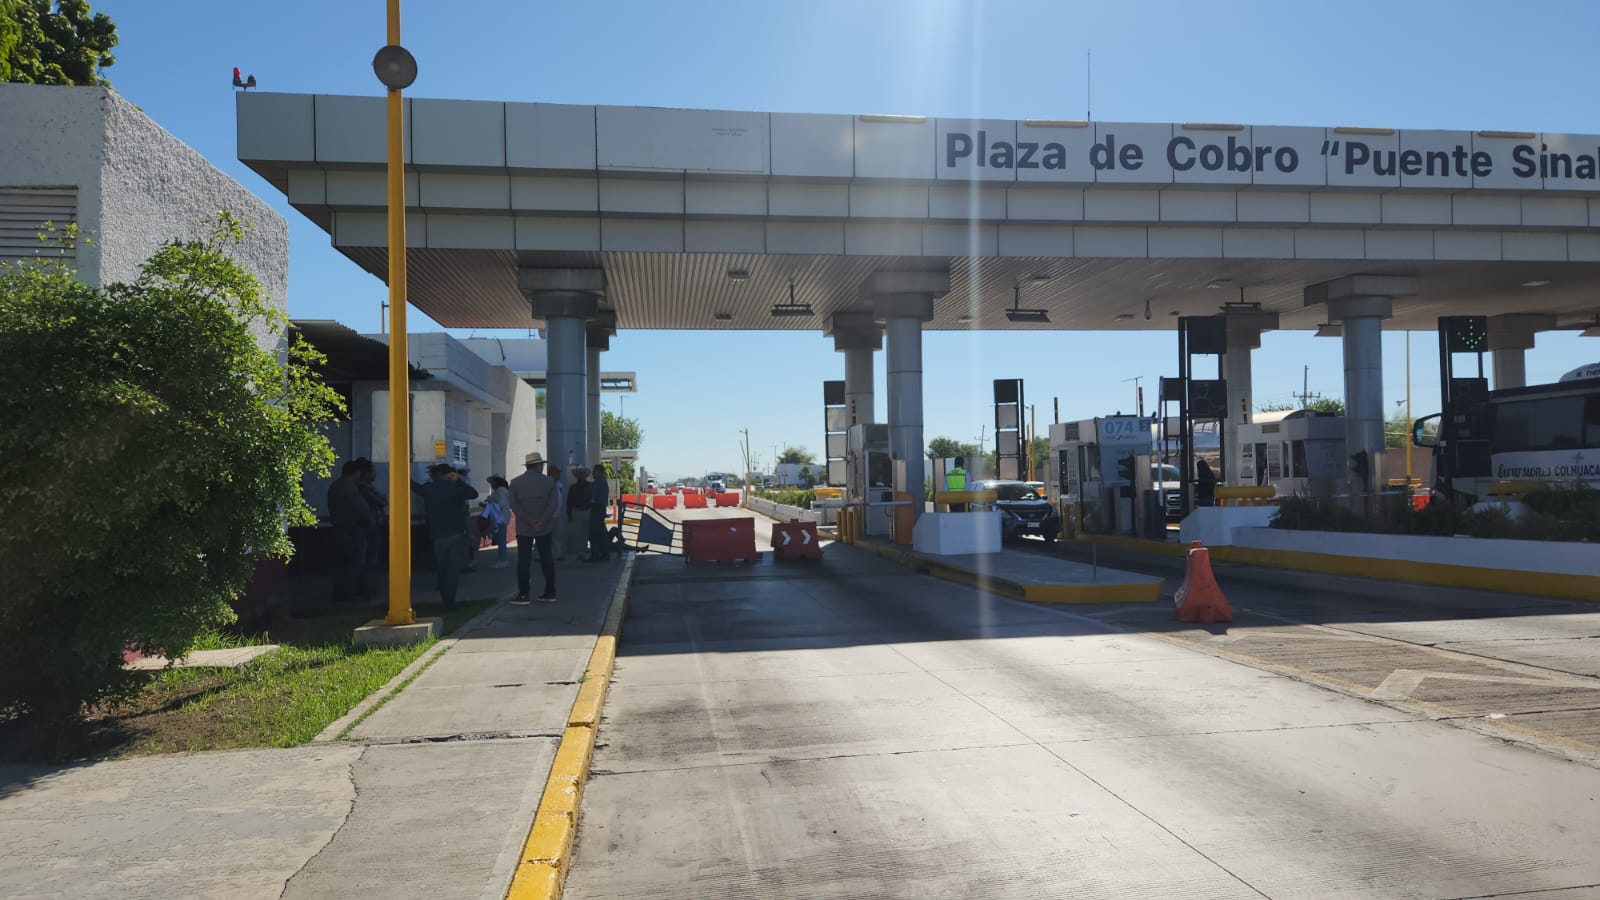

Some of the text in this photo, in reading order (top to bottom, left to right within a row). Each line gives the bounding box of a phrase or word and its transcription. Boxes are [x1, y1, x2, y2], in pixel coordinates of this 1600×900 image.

[946, 130, 1066, 169] Plaza
[1089, 134, 1143, 171] de
[1166, 135, 1299, 173] Cobro
[1104, 419, 1134, 433] 074
